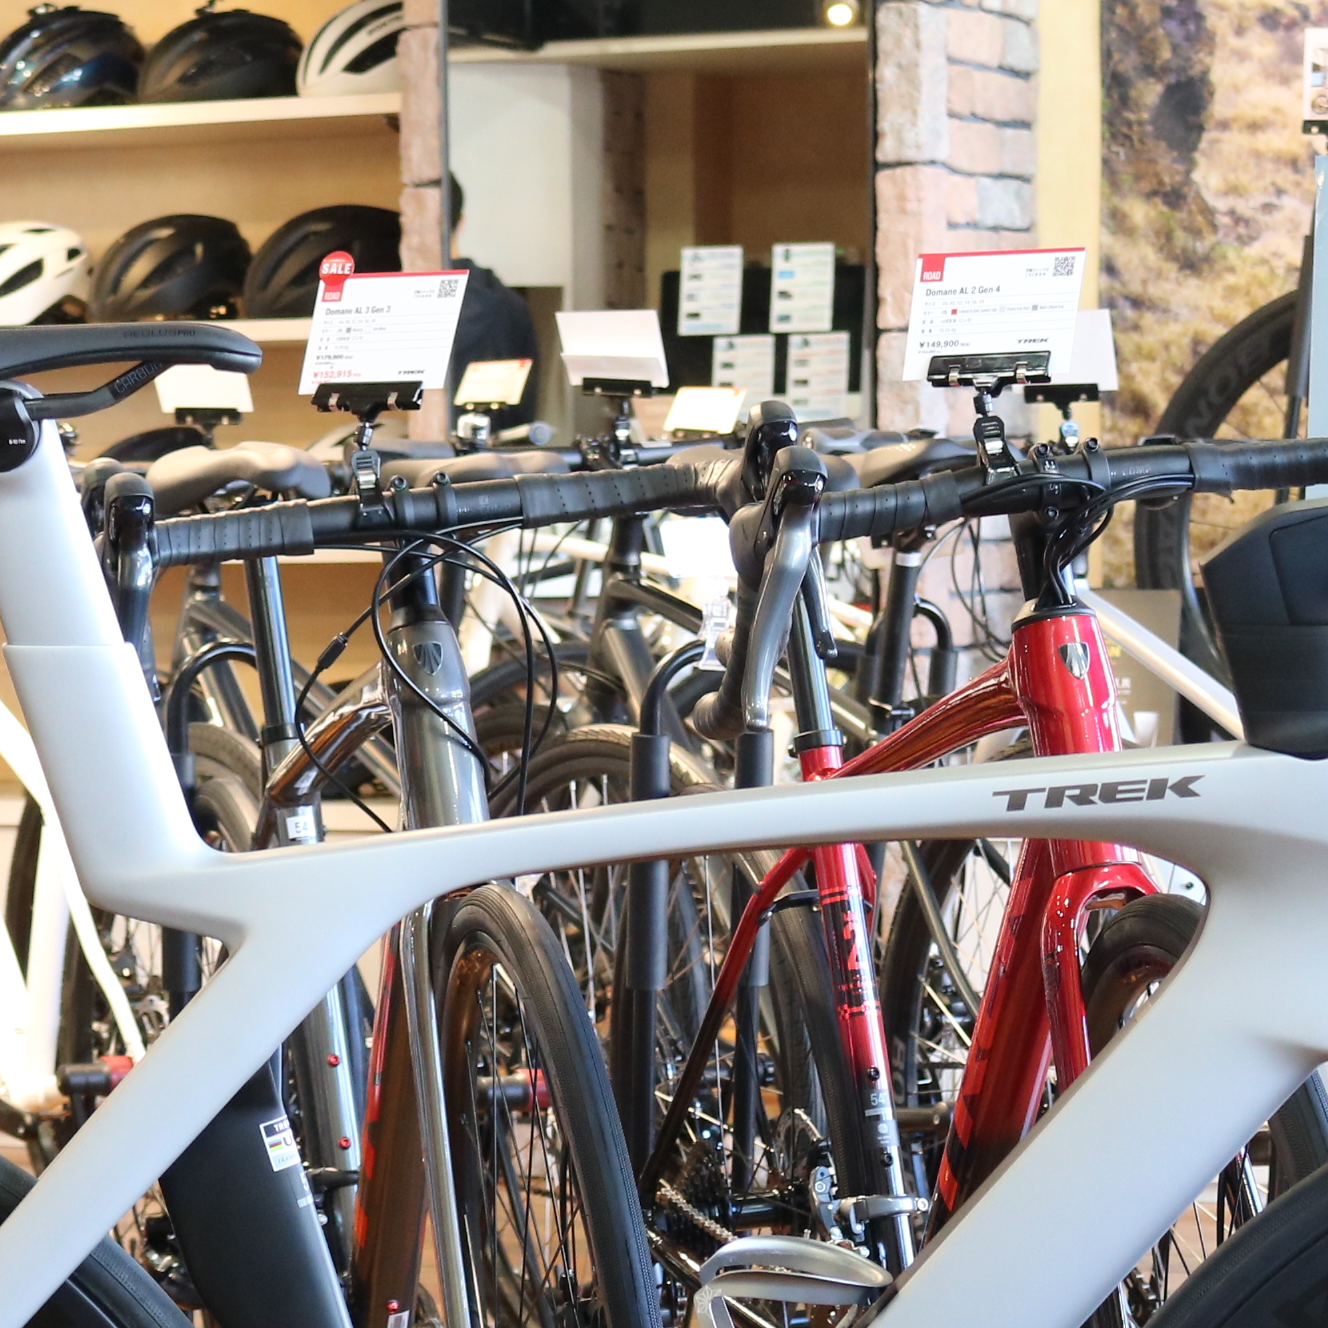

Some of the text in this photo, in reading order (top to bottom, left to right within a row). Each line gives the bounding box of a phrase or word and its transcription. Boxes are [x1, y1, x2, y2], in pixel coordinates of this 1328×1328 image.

[321, 263, 354, 275] SALE
[922, 271, 941, 281] ROAD
[925, 286, 958, 297] Domane
[978, 286, 994, 295] Gen
[325, 307, 353, 316] Domane
[371, 305, 385, 314] Gen
[919, 340, 960, 350] ¥149,900
[313, 370, 353, 379] ¥152,915
[992, 774, 1206, 812] TREK
